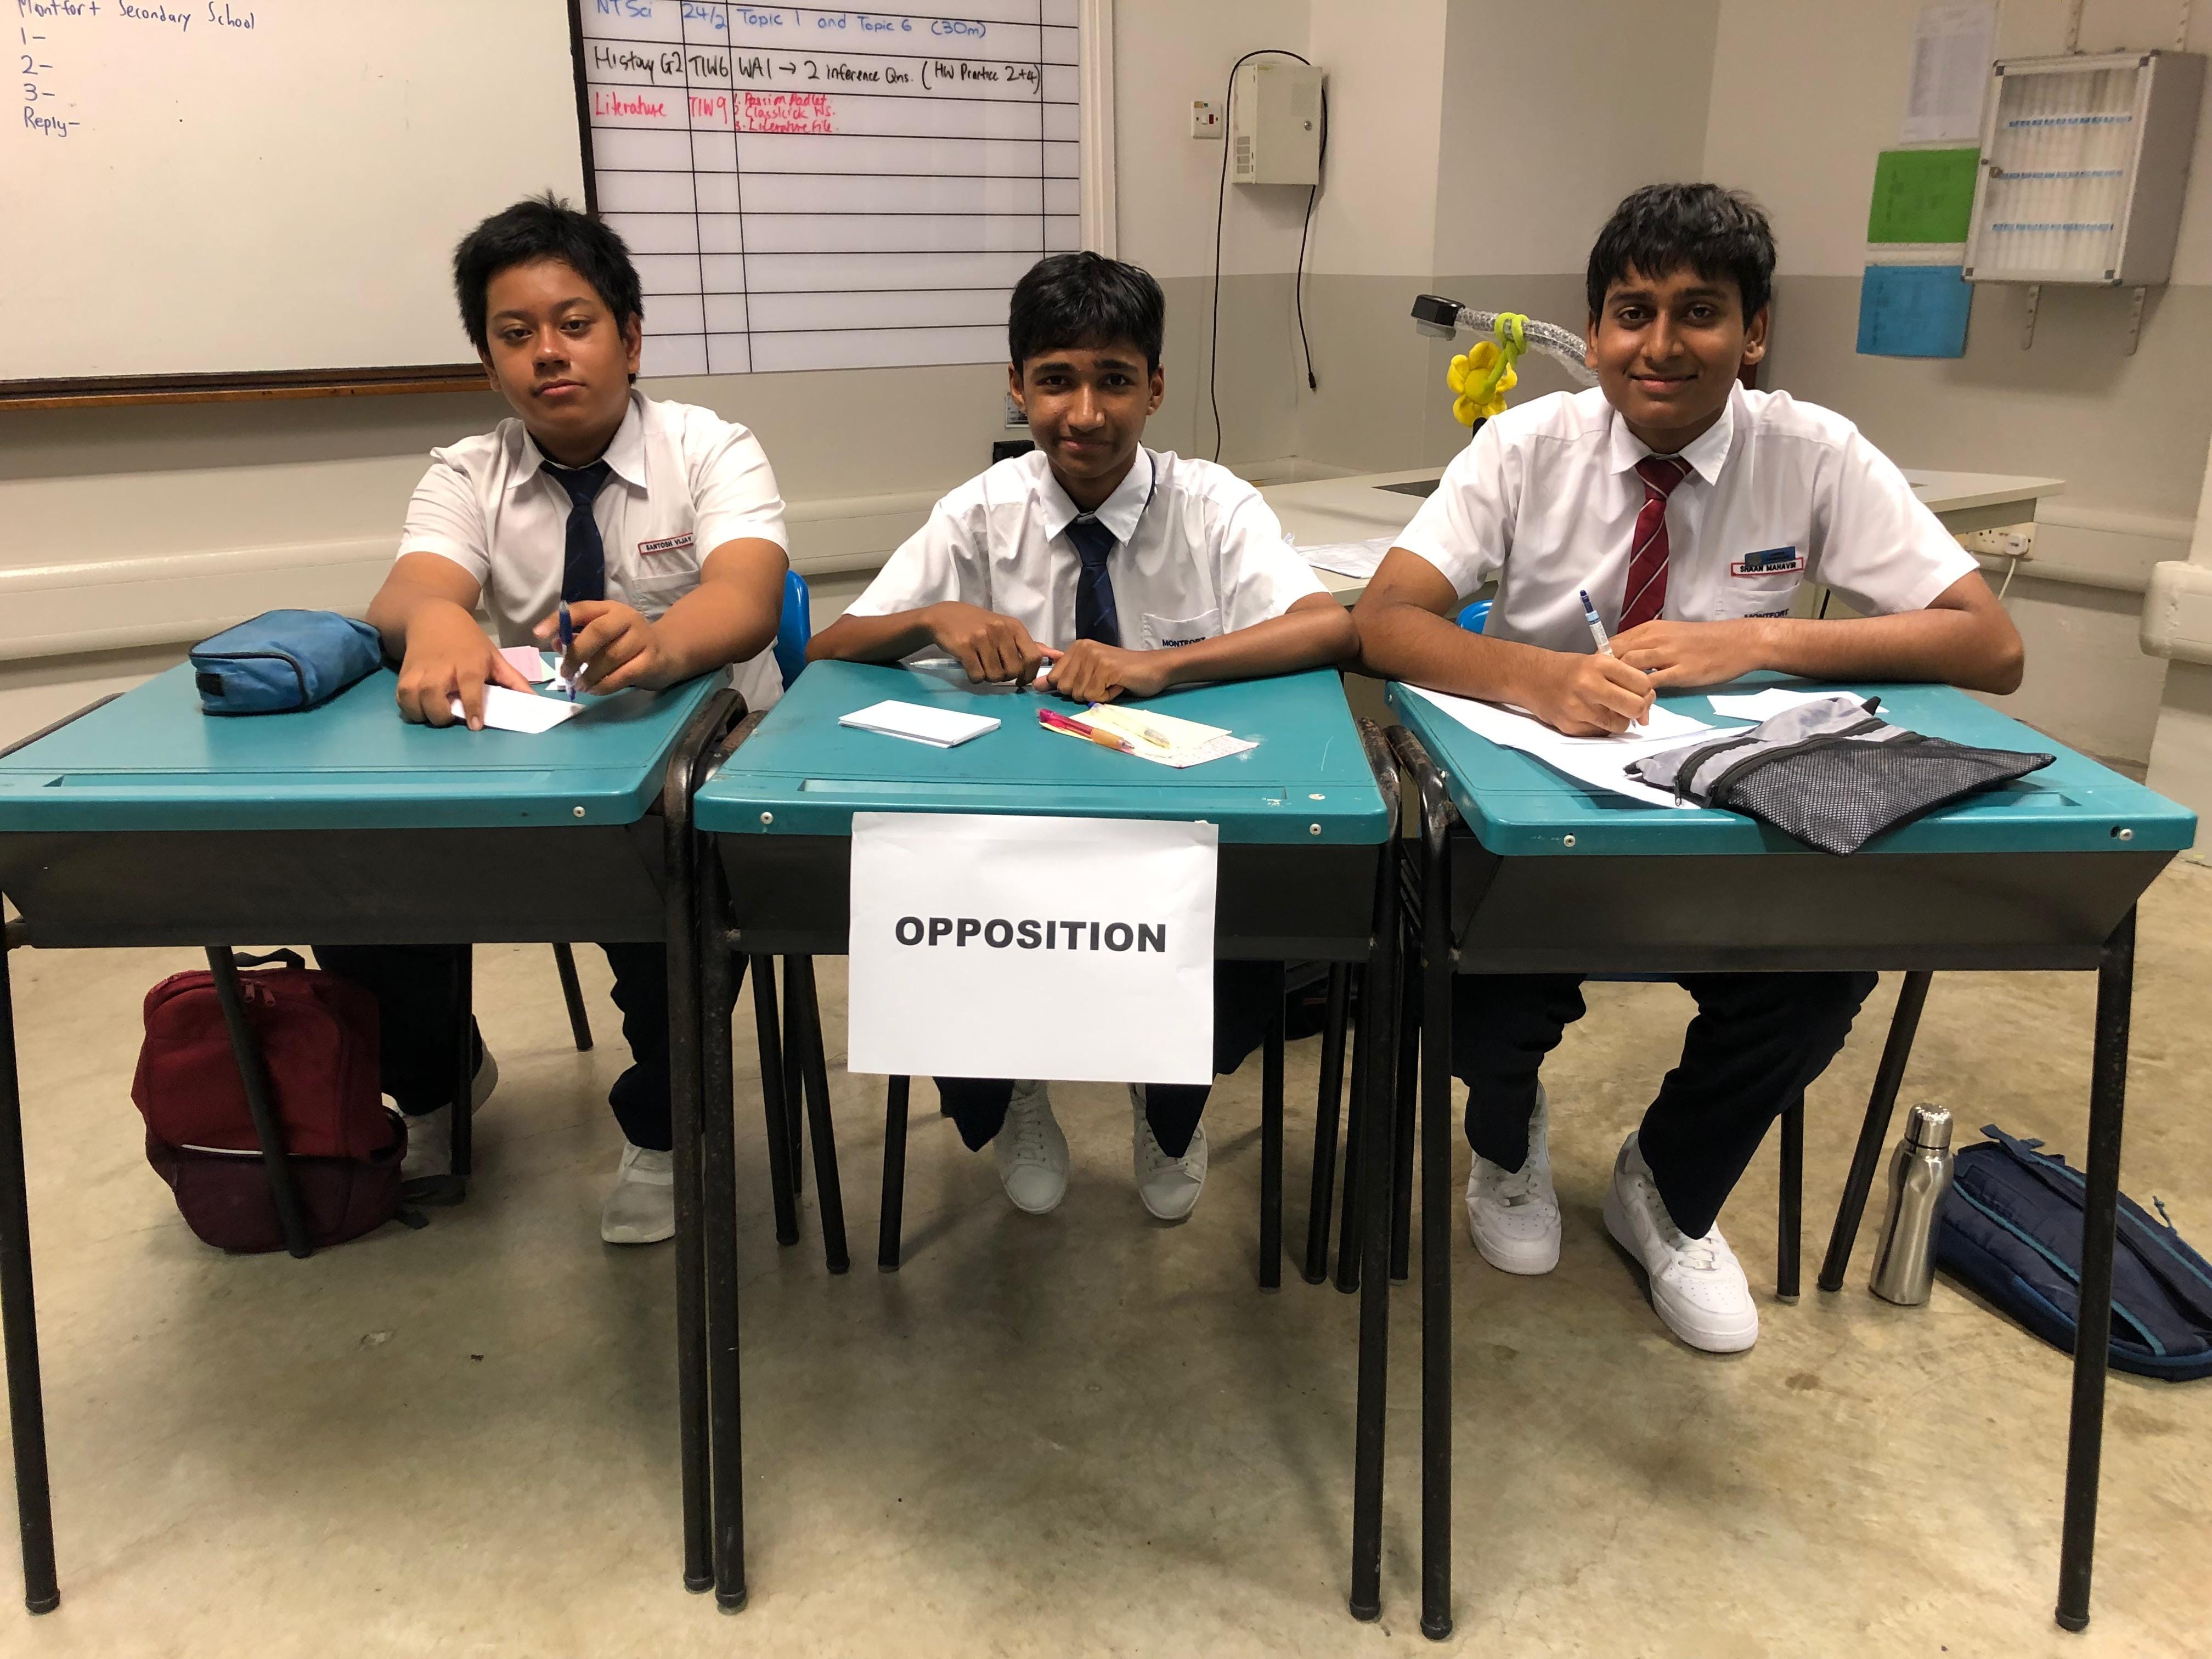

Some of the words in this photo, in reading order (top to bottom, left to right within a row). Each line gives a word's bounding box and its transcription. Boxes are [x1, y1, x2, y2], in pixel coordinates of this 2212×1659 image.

[120, 0, 191, 32] Secondary
[208, 1, 255, 30] School
[682, 3, 727, 30] 24/2
[737, 8, 783, 26] Topic
[817, 14, 846, 29] and
[857, 16, 895, 33] Topic
[901, 19, 912, 32] 6
[931, 20, 987, 38] (30m)
[661, 52, 684, 80] G2
[804, 60, 820, 79] 2
[595, 92, 668, 117] Literature
[646, 540, 673, 551] SANTOSH
[675, 536, 692, 545] VIJAY
[895, 916, 1166, 952] OPPOSITION
